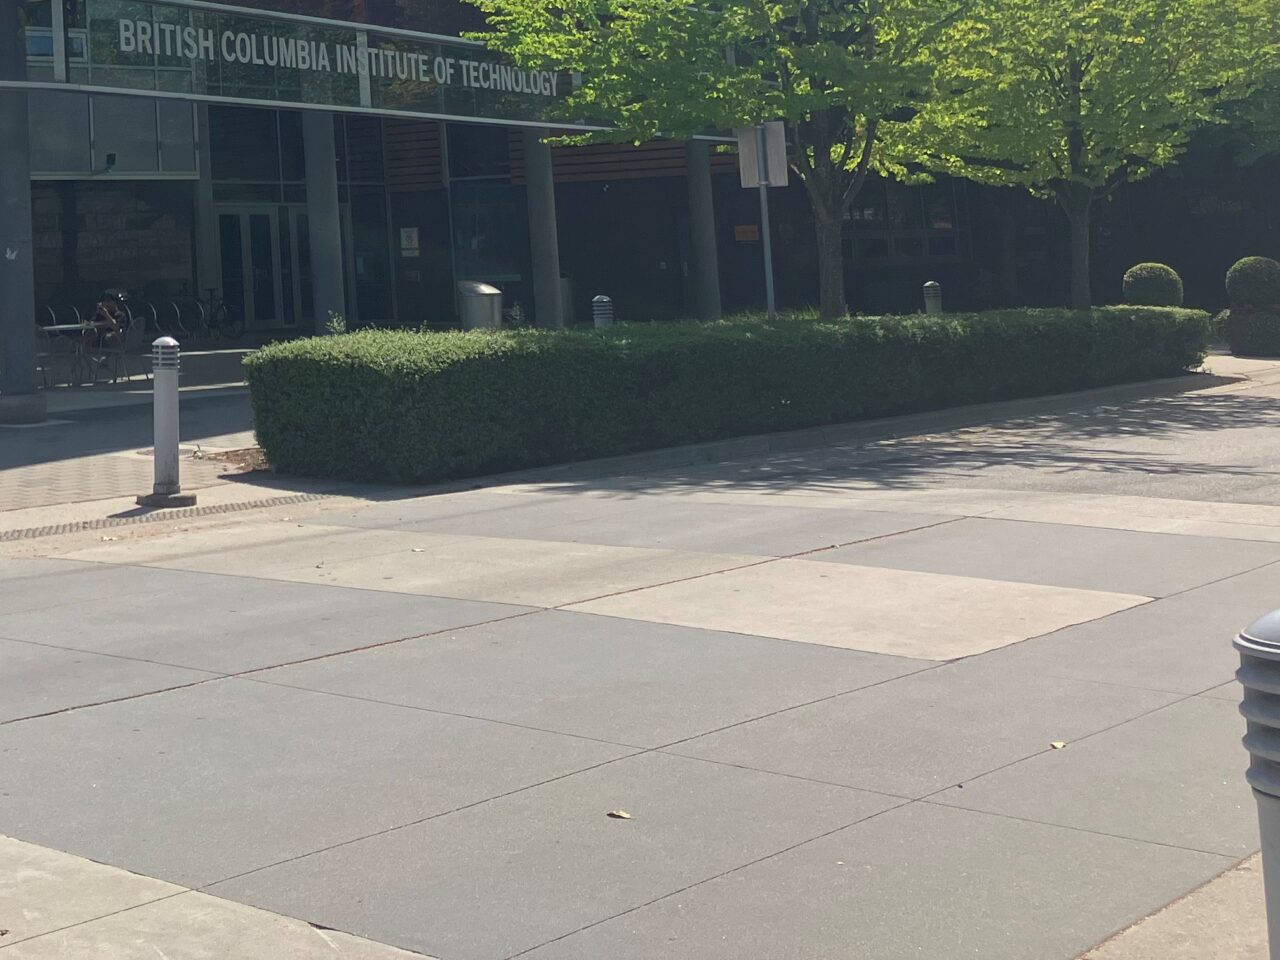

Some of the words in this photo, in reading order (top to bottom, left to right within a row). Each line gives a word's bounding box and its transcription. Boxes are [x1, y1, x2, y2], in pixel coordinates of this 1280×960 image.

[119, 19, 214, 60] BRITISH
[221, 31, 330, 71] COLUMBIA
[337, 44, 429, 82] INSTITUTE
[434, 57, 455, 85] OF
[459, 60, 558, 97] TECHNOLOGY
